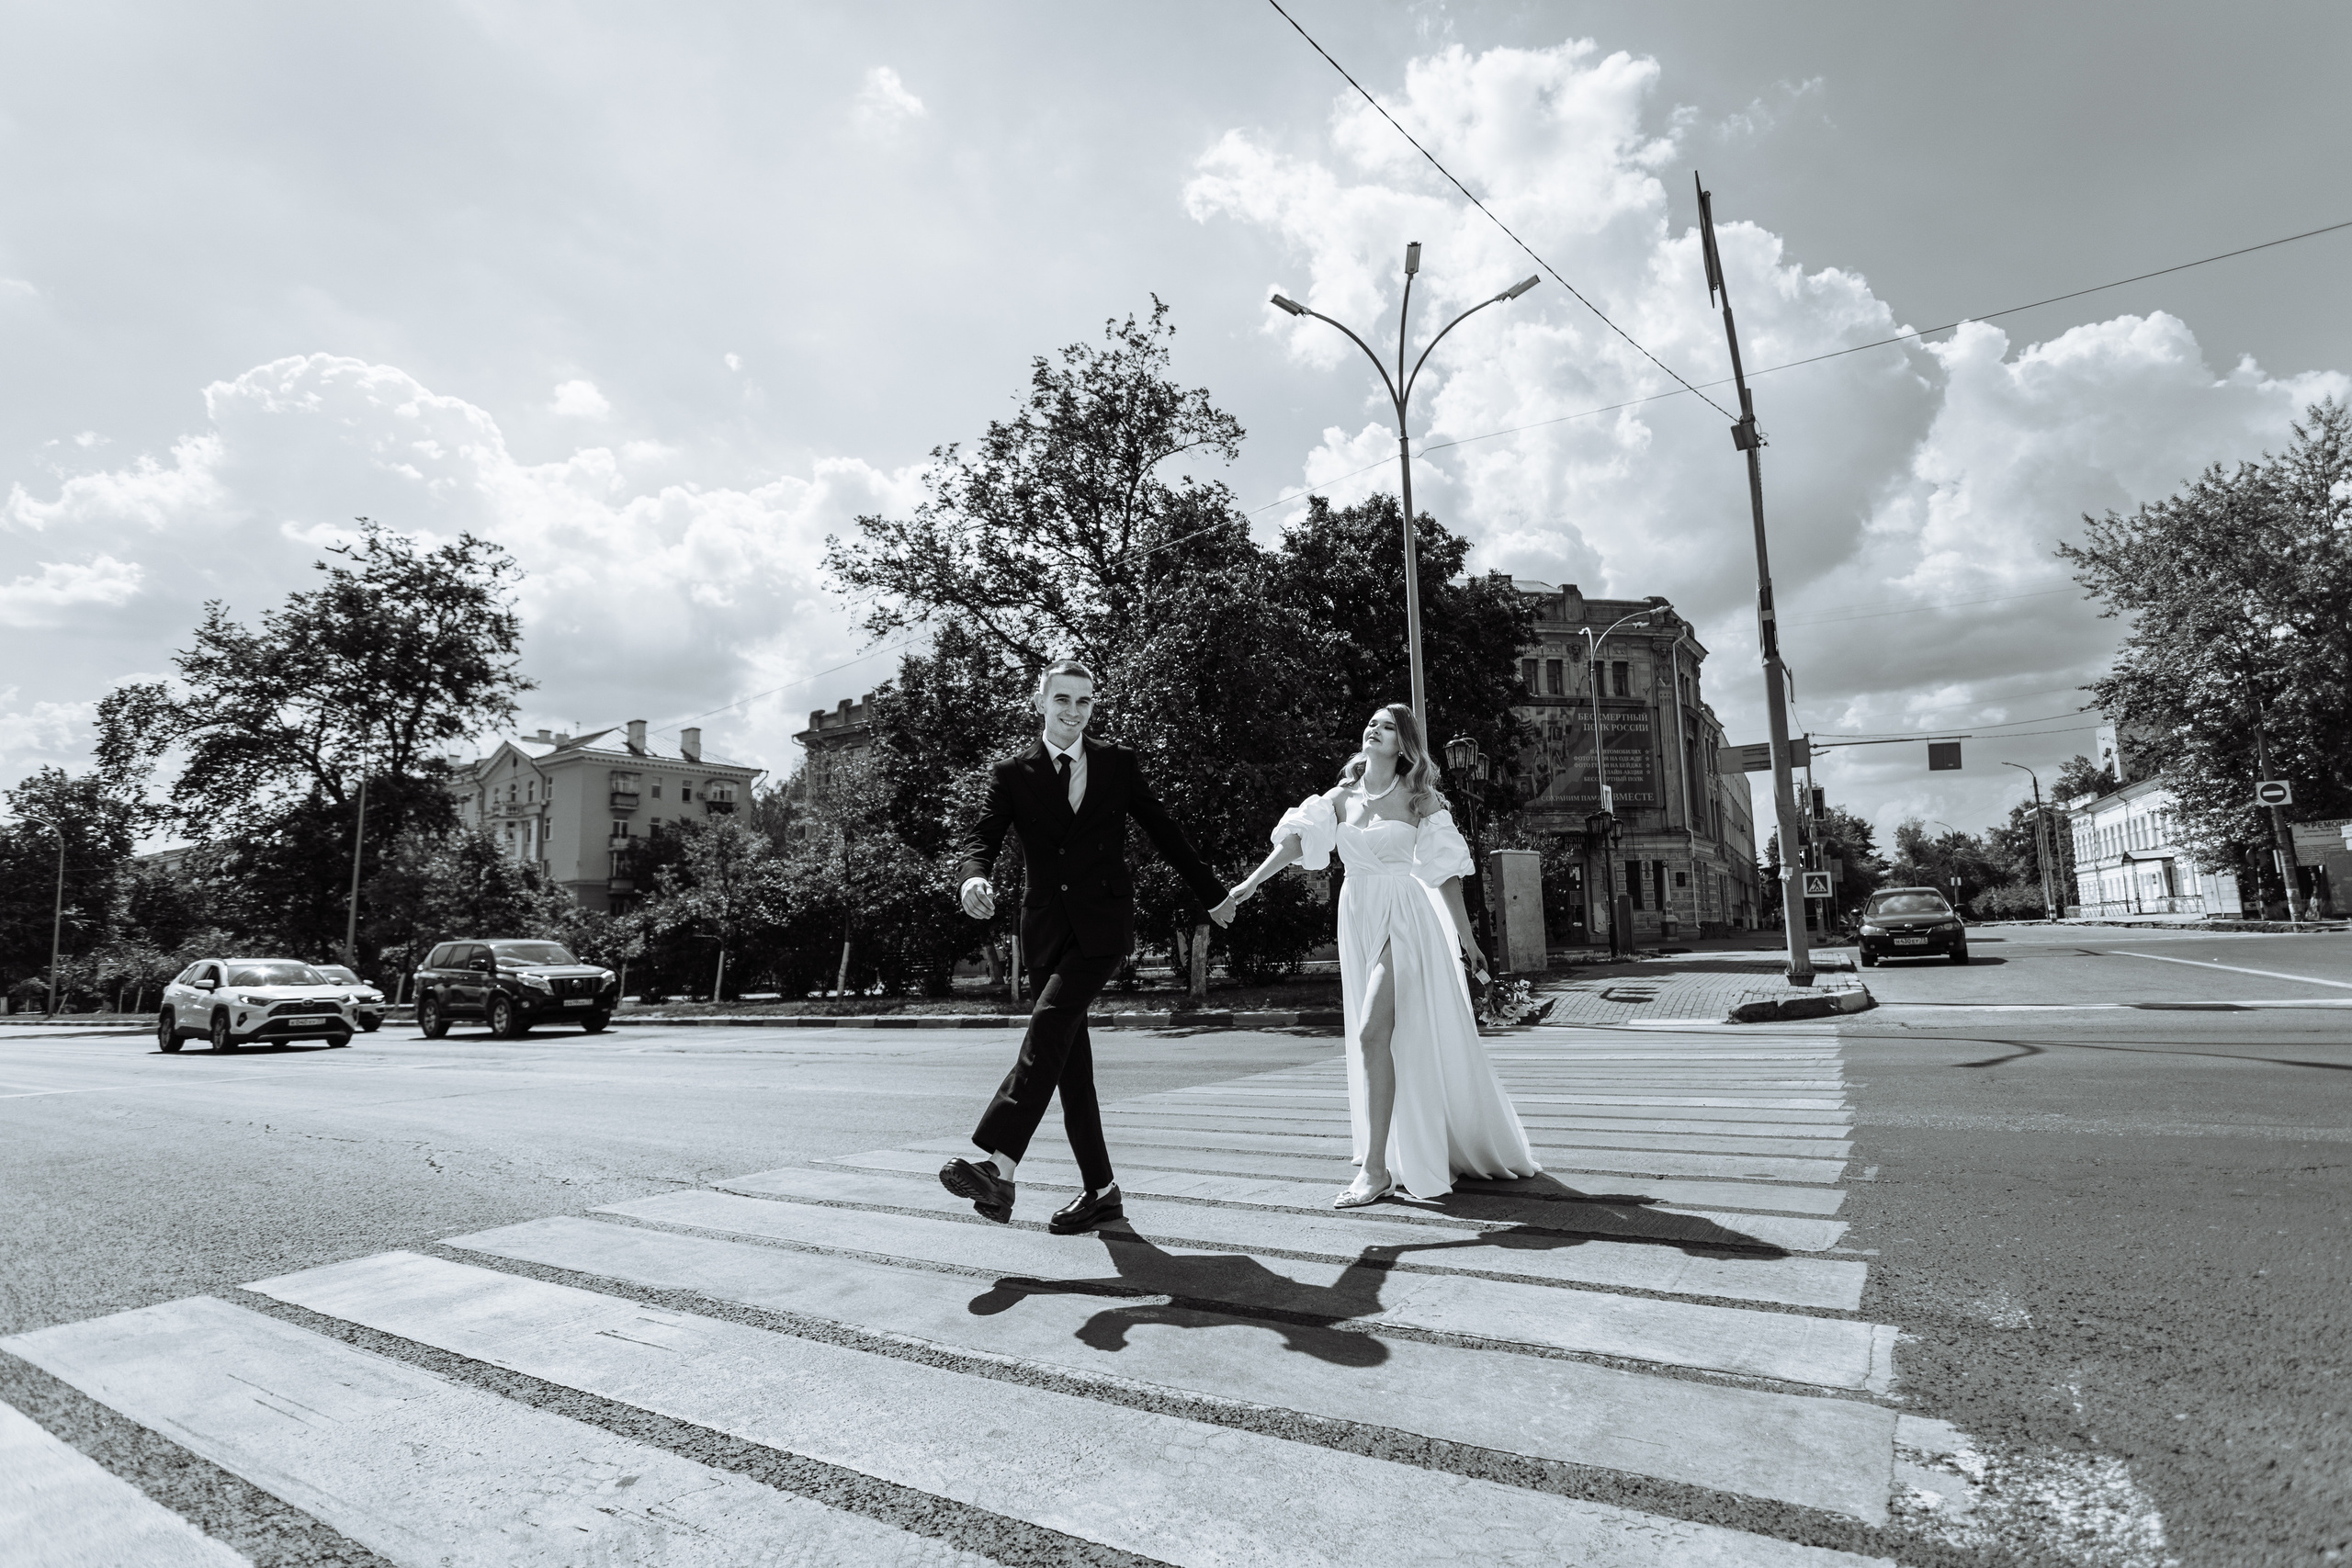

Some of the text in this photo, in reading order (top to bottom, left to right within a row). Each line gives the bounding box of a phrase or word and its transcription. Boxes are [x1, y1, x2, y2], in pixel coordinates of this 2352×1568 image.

[1611, 724, 1648, 732] РОССИИ
[1612, 792, 1655, 801] ВМЕСТЕ
[1565, 842, 1583, 851] БАНК
